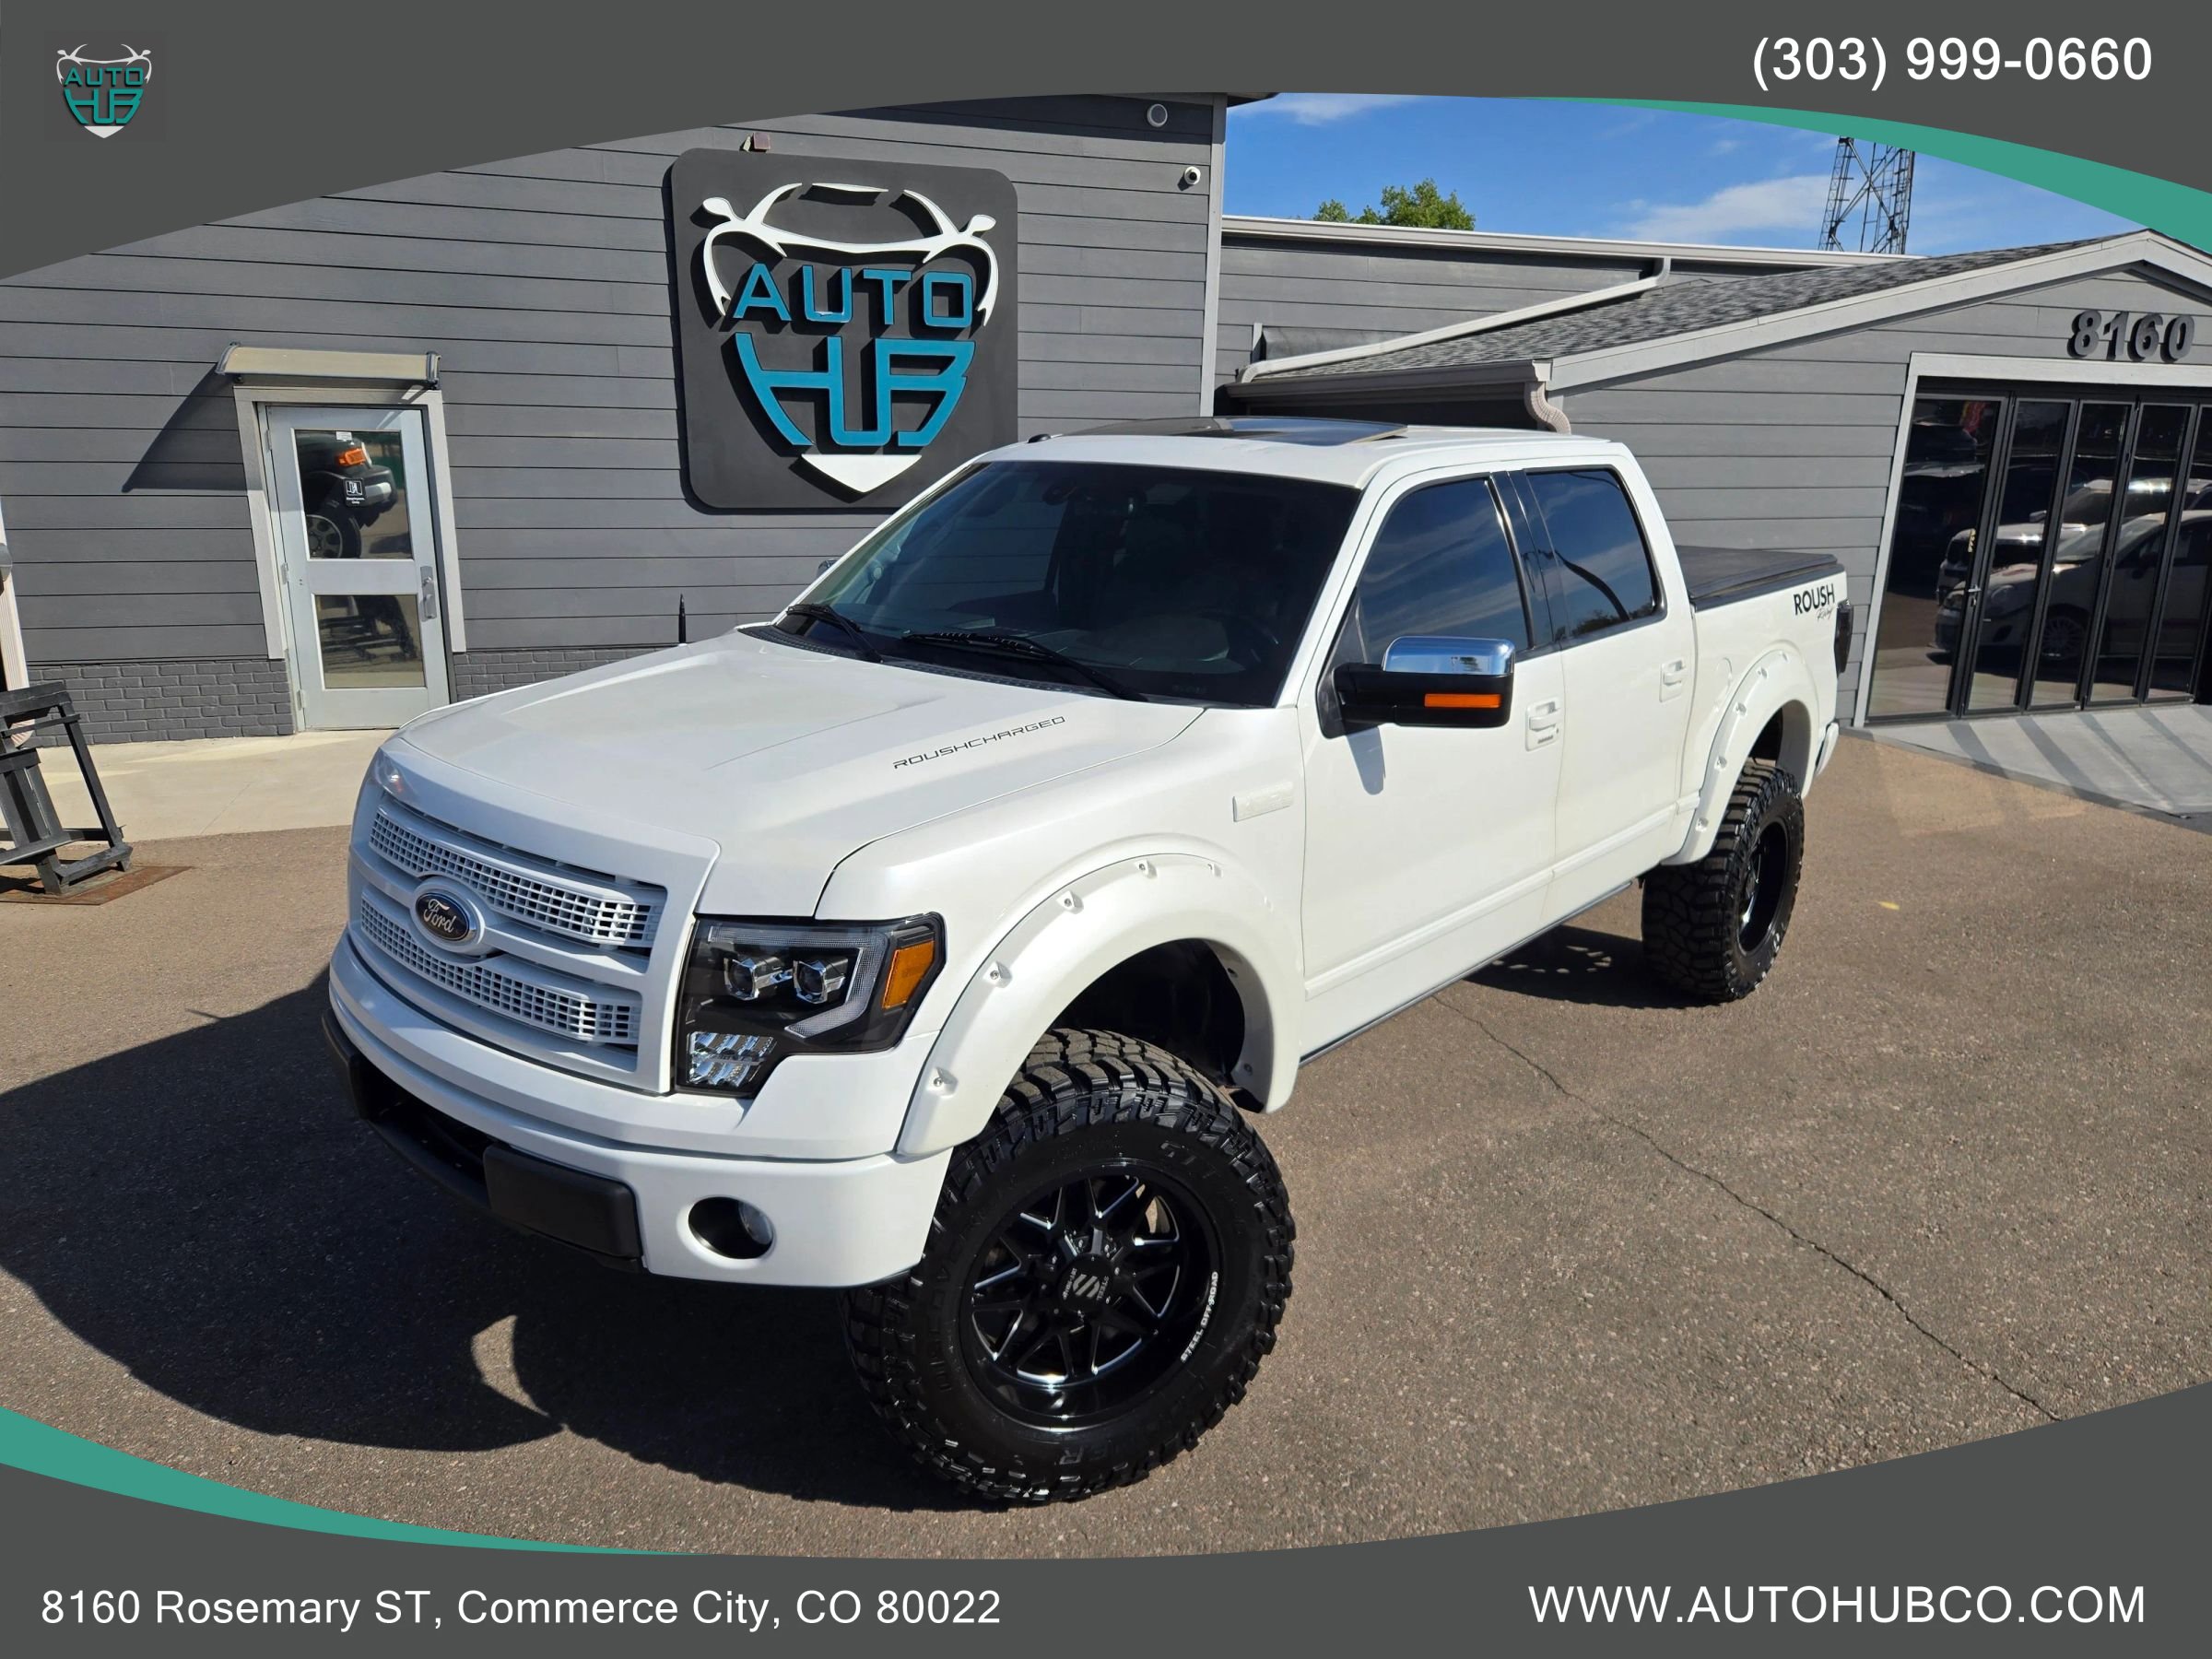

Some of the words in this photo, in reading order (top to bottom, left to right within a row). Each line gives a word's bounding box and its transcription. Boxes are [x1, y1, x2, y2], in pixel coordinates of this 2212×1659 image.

[732, 263, 973, 328] AUTO
[2068, 310, 2195, 362] 8160
[735, 332, 976, 447] HUB
[1793, 582, 1835, 616] ROUSH
[892, 715, 1066, 770] ROUSHCHARGED
[423, 899, 457, 933] Ford
[1181, 1329, 1204, 1363] STEEL
